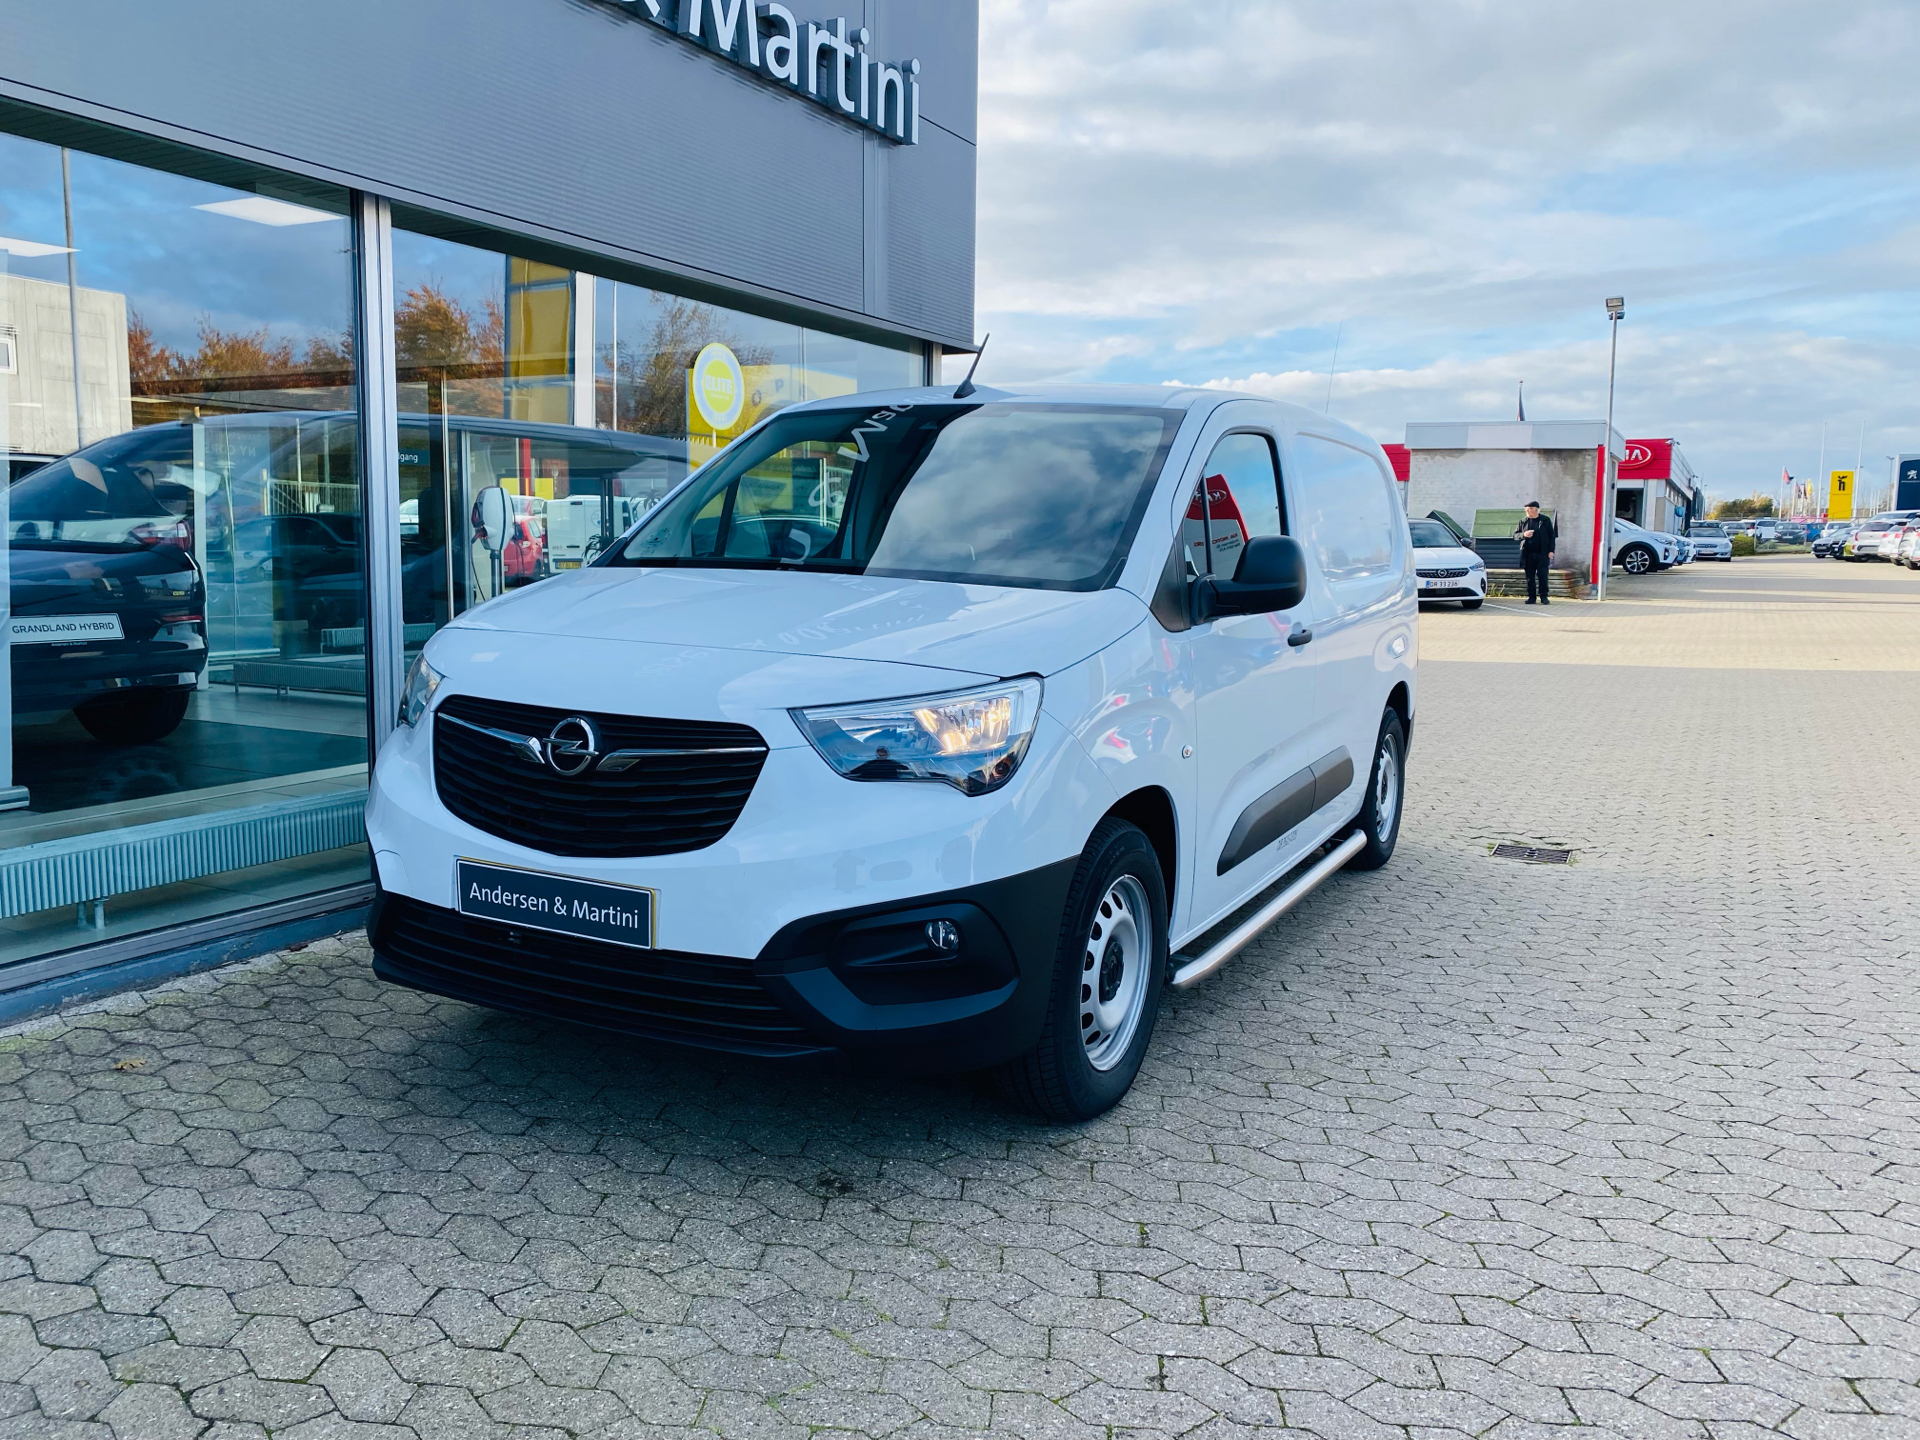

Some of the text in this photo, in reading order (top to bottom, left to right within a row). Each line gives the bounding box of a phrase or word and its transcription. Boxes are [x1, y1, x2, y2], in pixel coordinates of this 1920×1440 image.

[688, 0, 921, 145] Martini
[705, 374, 733, 395] ELITE
[397, 451, 418, 464] gang
[1625, 449, 1643, 461] IA
[12, 622, 115, 634] GRANDLAND HYBRID
[469, 882, 639, 929] Andersen & Martini
